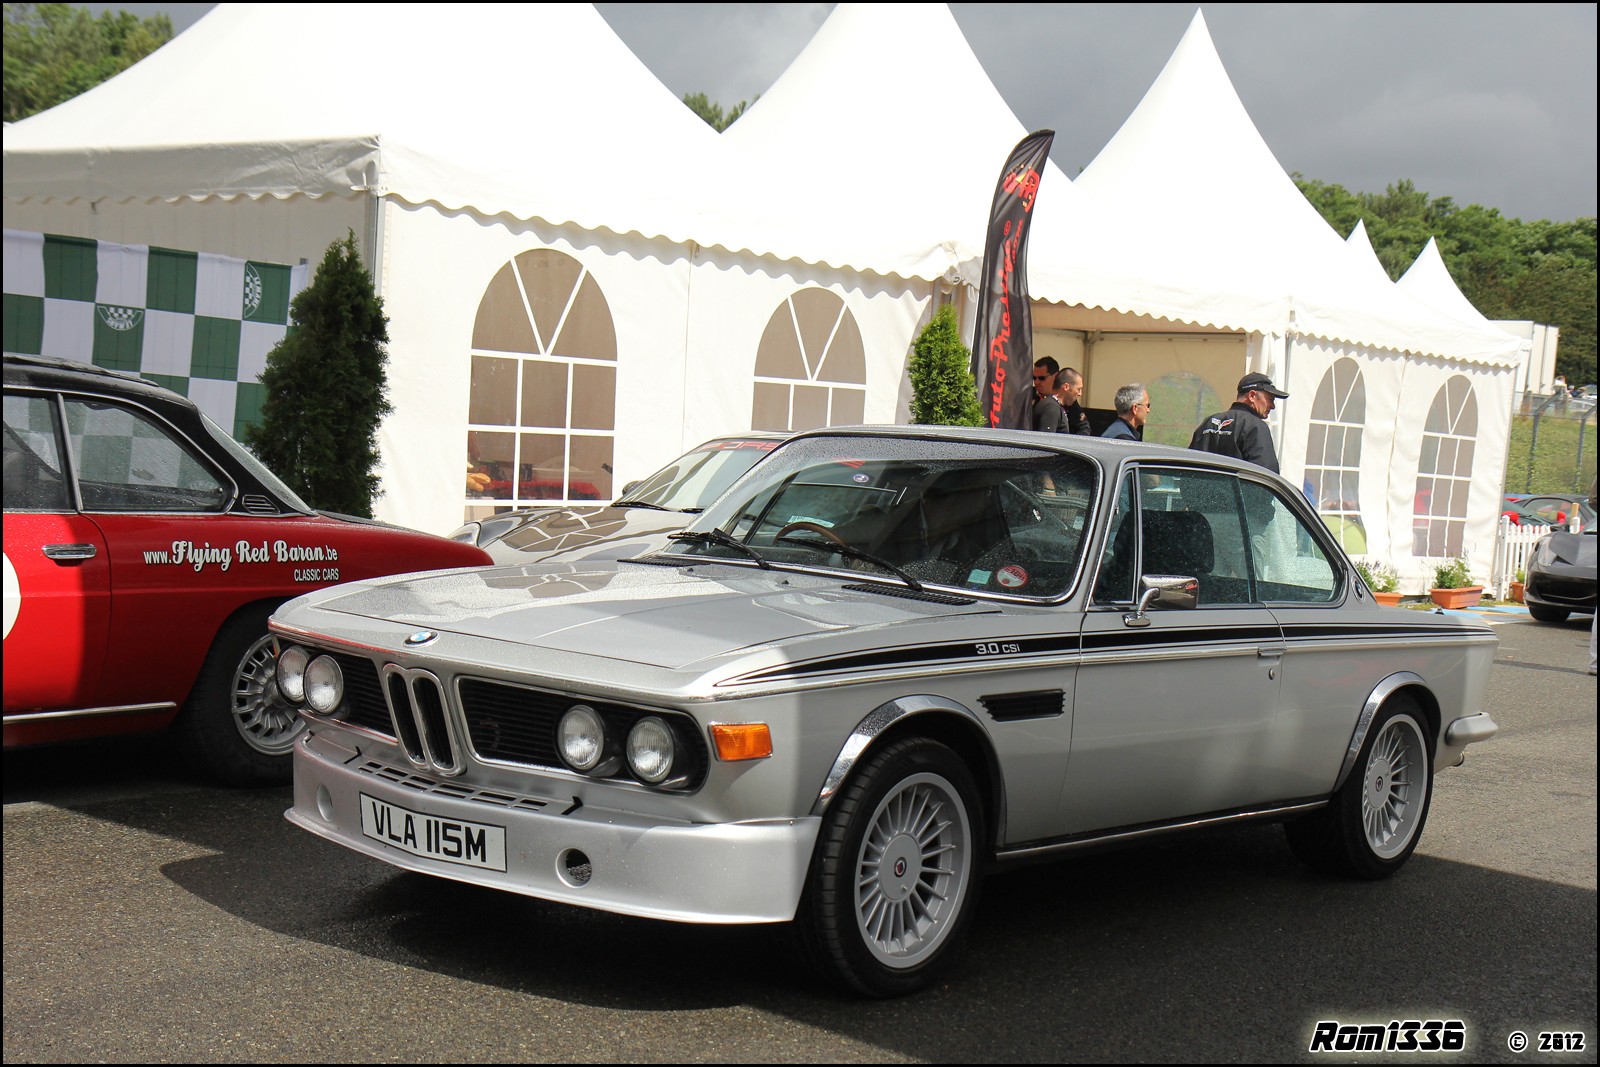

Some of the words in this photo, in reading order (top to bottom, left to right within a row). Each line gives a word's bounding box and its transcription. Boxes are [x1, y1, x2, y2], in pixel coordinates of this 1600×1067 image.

[696, 441, 781, 452] PORS
[143, 540, 232, 572] www.Flying
[235, 540, 270, 563] Red
[273, 540, 338, 563] Baron.be
[294, 568, 321, 582] CLASSIC
[322, 567, 339, 581] CARS
[975, 643, 1000, 655] 3.0
[372, 801, 418, 849] VLA
[426, 819, 486, 863] 115M
